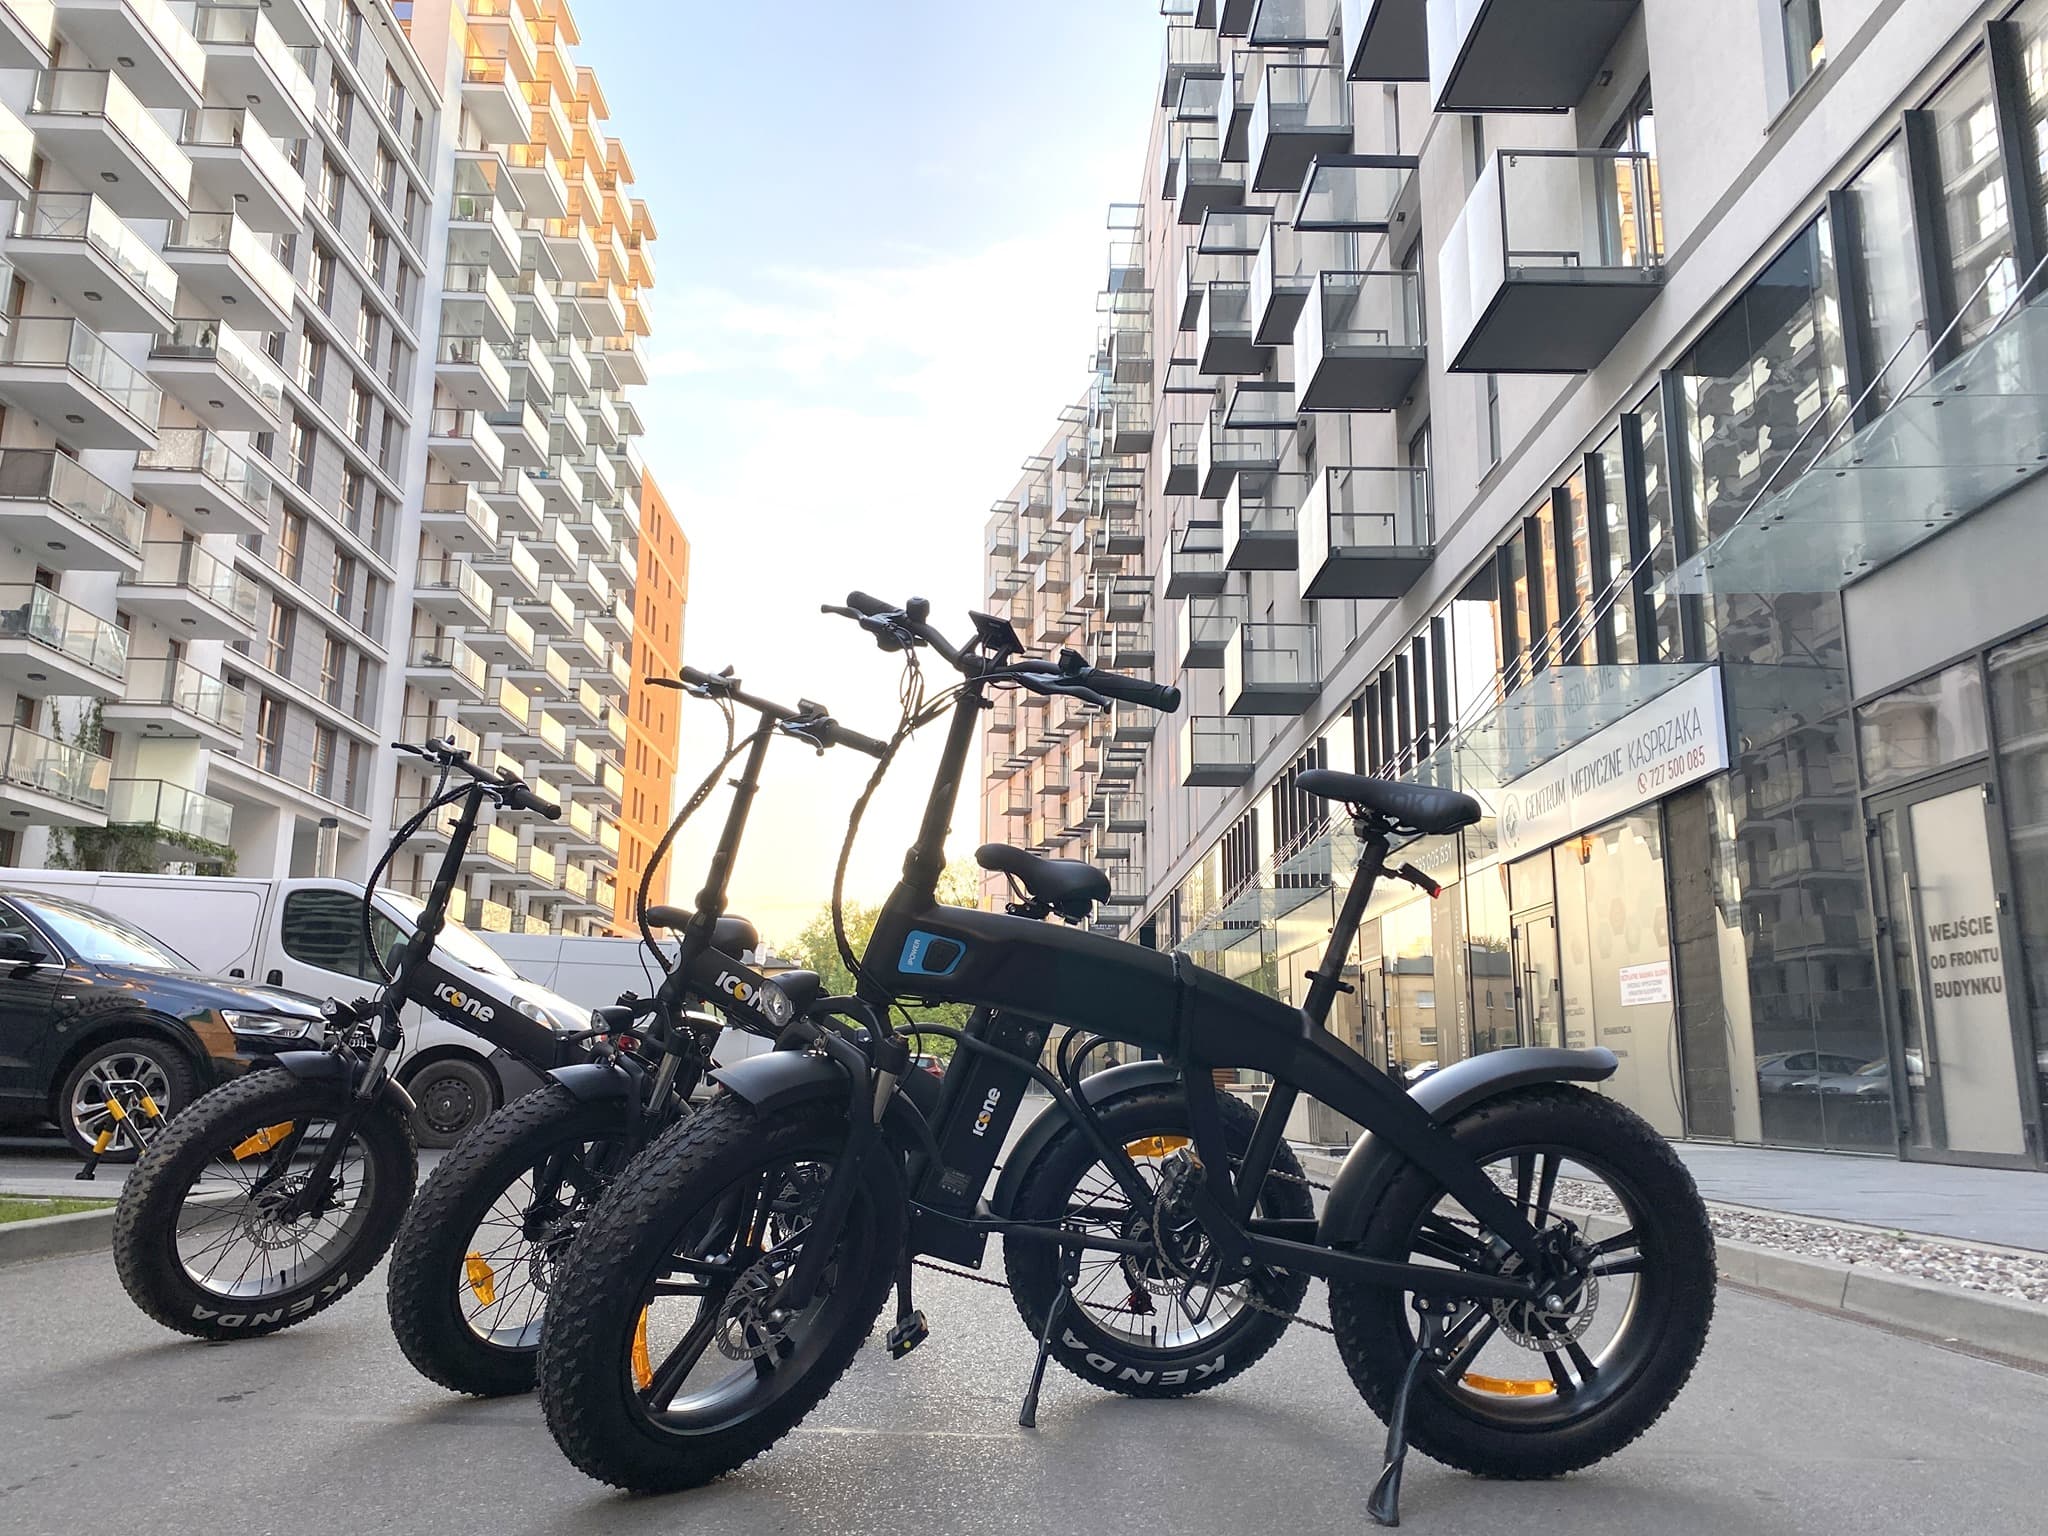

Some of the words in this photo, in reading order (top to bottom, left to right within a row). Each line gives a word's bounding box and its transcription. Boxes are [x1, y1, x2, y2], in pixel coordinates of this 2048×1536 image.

[1525, 778, 1566, 821] CENTRUM
[1570, 748, 1623, 799] MEDYCZNE
[1627, 707, 1703, 772] KASPRZAKA
[1649, 765, 1666, 789] 727
[1668, 756, 1685, 779] 500
[1687, 745, 1706, 771] 085
[1929, 916, 1993, 942] WEJŚCIE
[1930, 954, 1946, 969] OD
[1950, 947, 1999, 967] FRONTU
[1934, 976, 2002, 999] BUDYNKU
[192, 1271, 348, 1328] KENDA
[1061, 1327, 1226, 1386] KENDA
